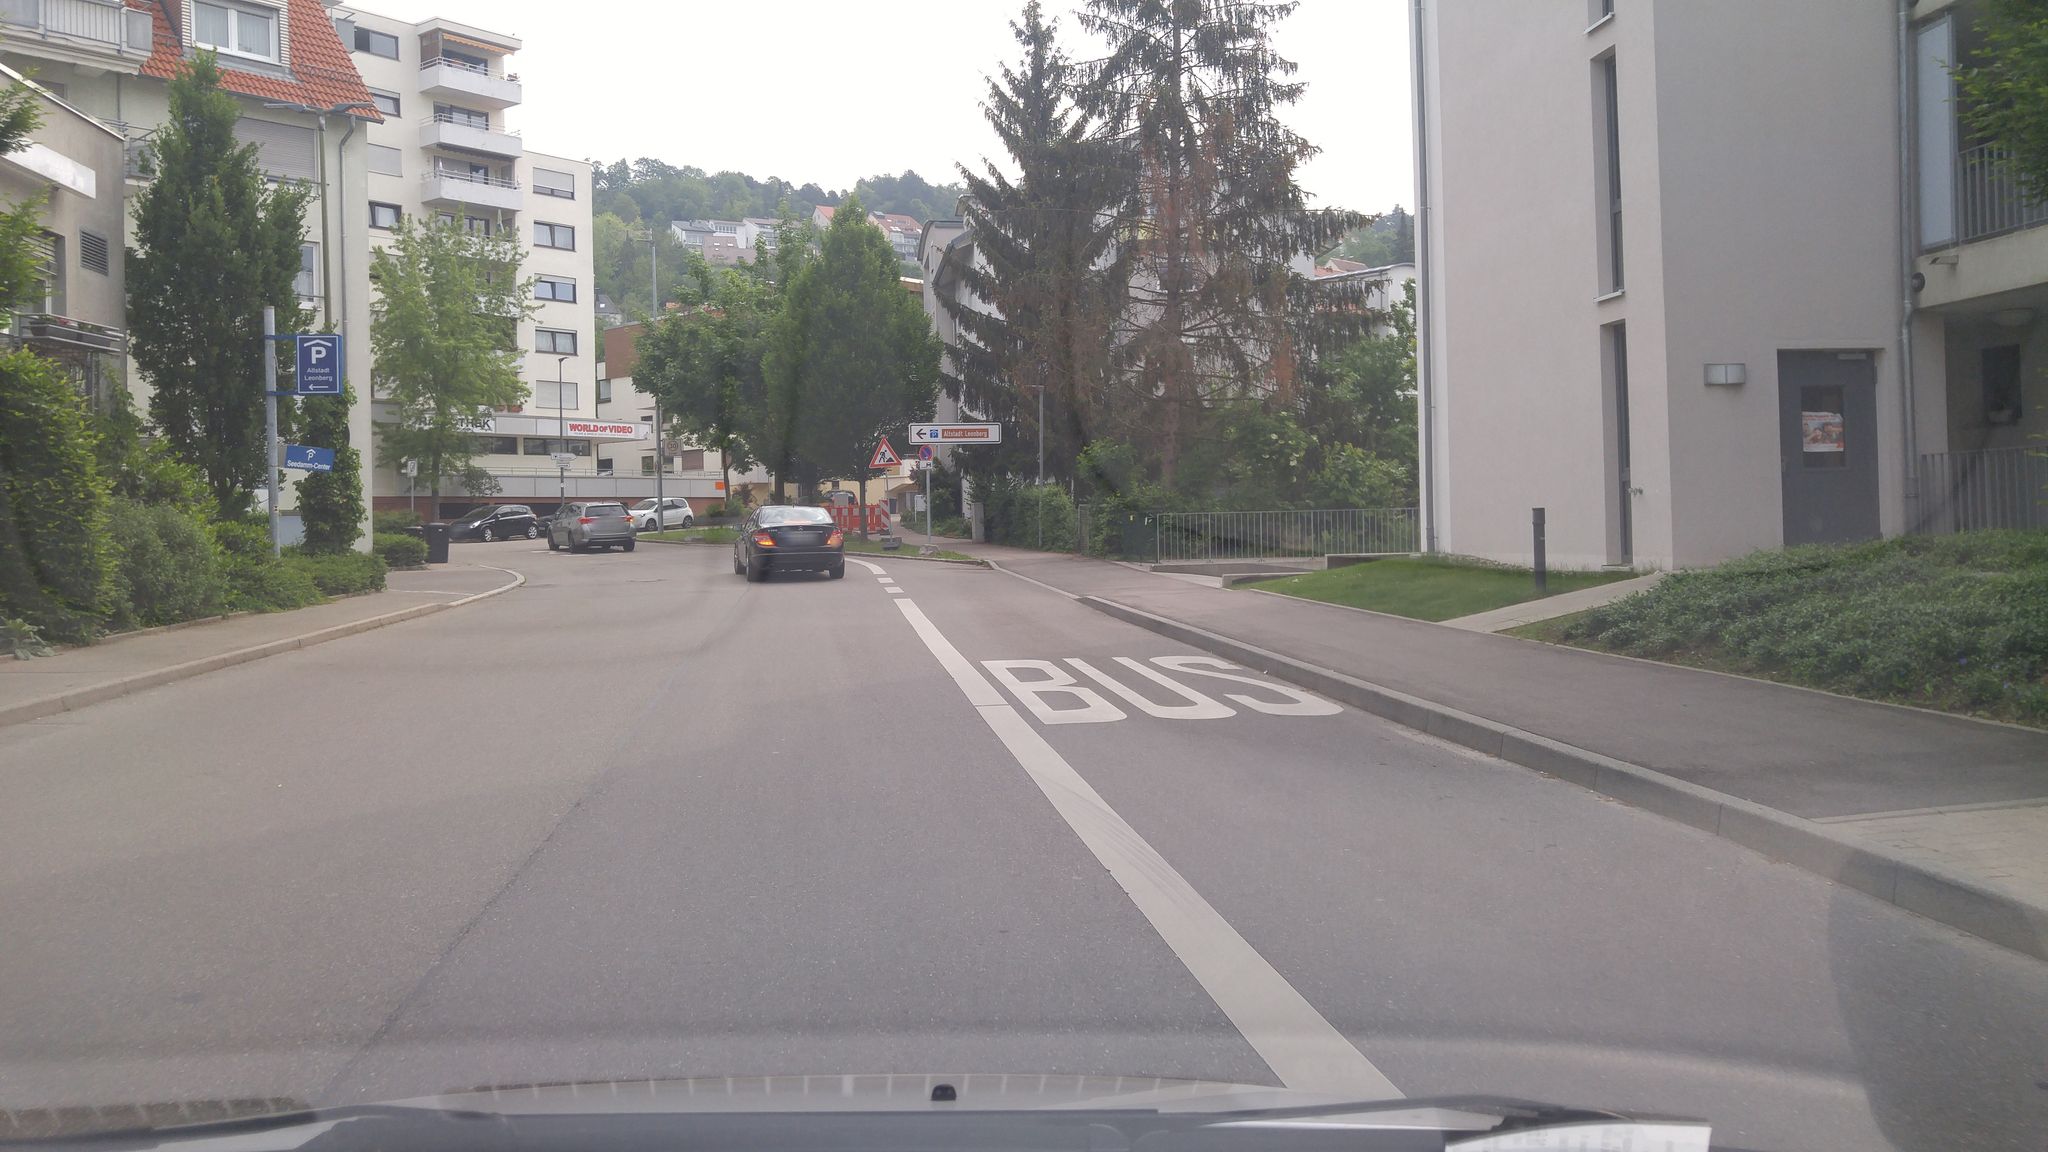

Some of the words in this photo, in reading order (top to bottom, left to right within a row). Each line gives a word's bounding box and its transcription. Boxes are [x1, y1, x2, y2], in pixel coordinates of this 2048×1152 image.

[311, 346, 327, 364] P
[569, 423, 599, 432] WORLD
[599, 425, 608, 433] OF
[608, 425, 633, 434] VIDEO
[965, 430, 988, 438] Leonberg
[286, 460, 331, 470] Seedamm-Center
[980, 656, 1345, 725] BUS
